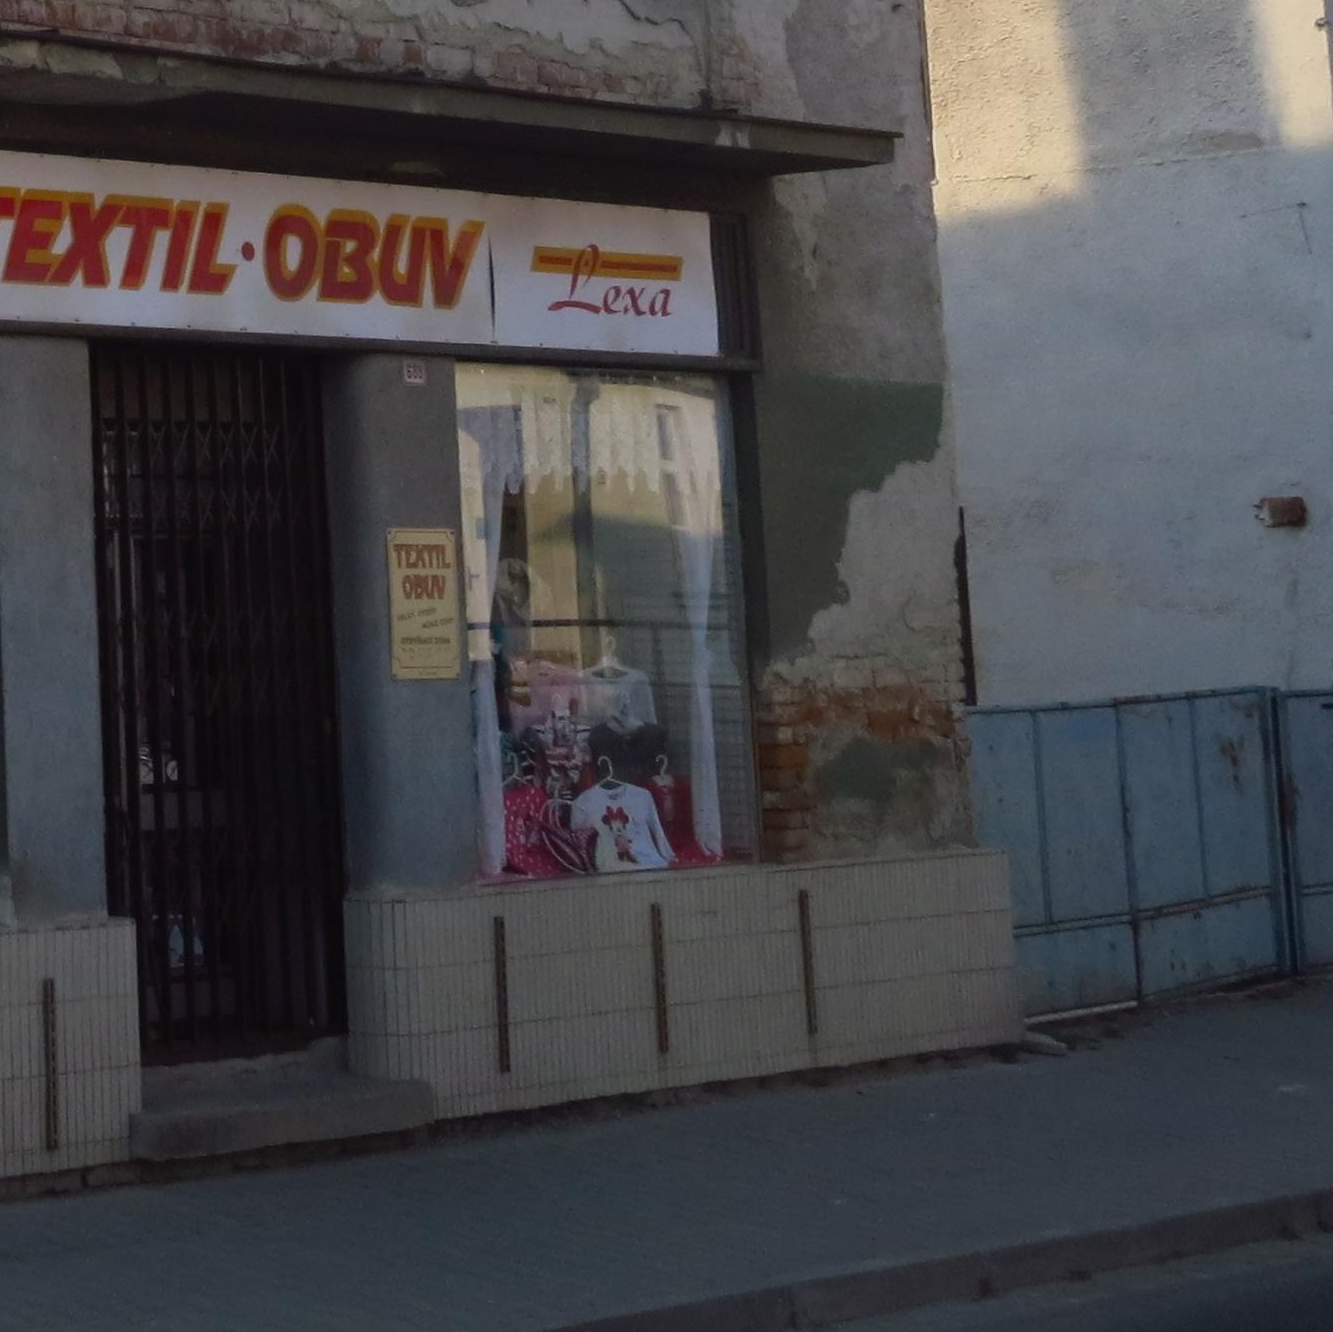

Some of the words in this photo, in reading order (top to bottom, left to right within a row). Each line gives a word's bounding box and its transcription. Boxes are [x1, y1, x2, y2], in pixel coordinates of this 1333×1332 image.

[263, 203, 486, 310] OBUV
[548, 244, 672, 317] Lexa
[393, 544, 451, 569] TEXTIL
[402, 574, 446, 600] OBUV
